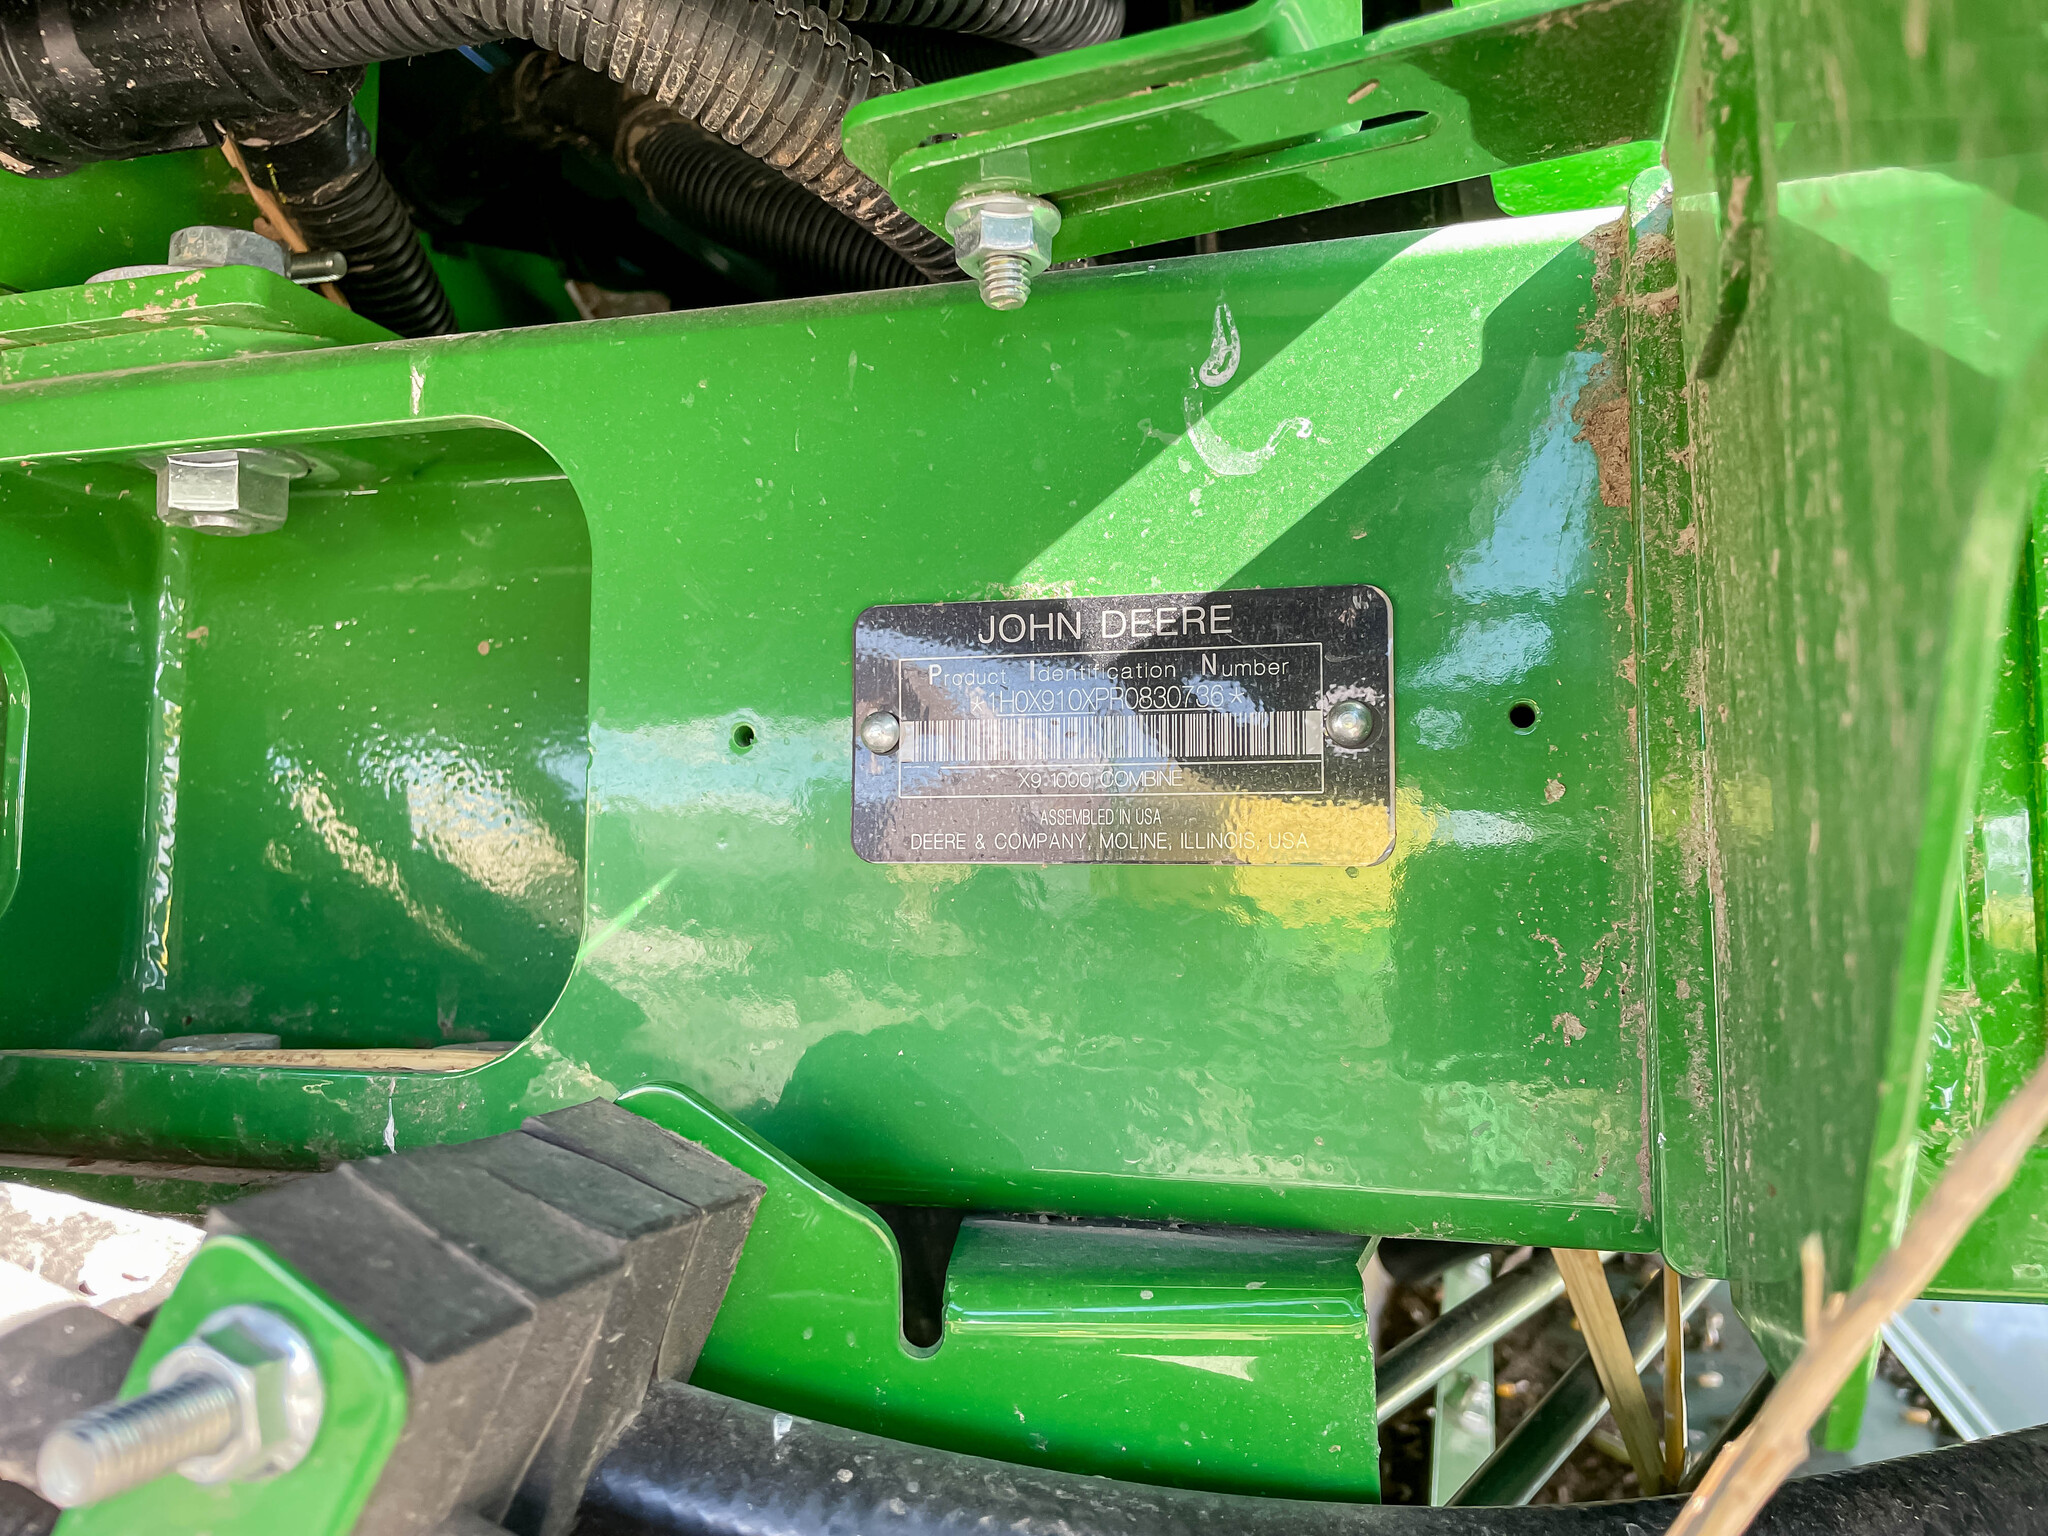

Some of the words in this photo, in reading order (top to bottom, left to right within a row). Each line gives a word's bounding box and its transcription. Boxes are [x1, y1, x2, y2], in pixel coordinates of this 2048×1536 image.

[978, 611, 1081, 644] JOHN
[1102, 604, 1232, 639] DEERE
[928, 664, 1007, 686] Product
[1029, 660, 1176, 682] Identification
[1201, 652, 1290, 677] Number
[1018, 772, 1042, 789] X9
[1050, 771, 1092, 788] 1000
[1100, 769, 1183, 788] COMBINE
[1039, 808, 1114, 826] ASSEMBLED
[1119, 808, 1131, 825] IN
[1136, 808, 1162, 825] USA
[910, 833, 967, 850] DEERE
[974, 833, 986, 850] &
[994, 832, 1092, 851] COMPANY,
[1099, 832, 1172, 851] MOLINE,
[1180, 831, 1260, 851] ILLINOIS,
[1268, 831, 1310, 850] USA
